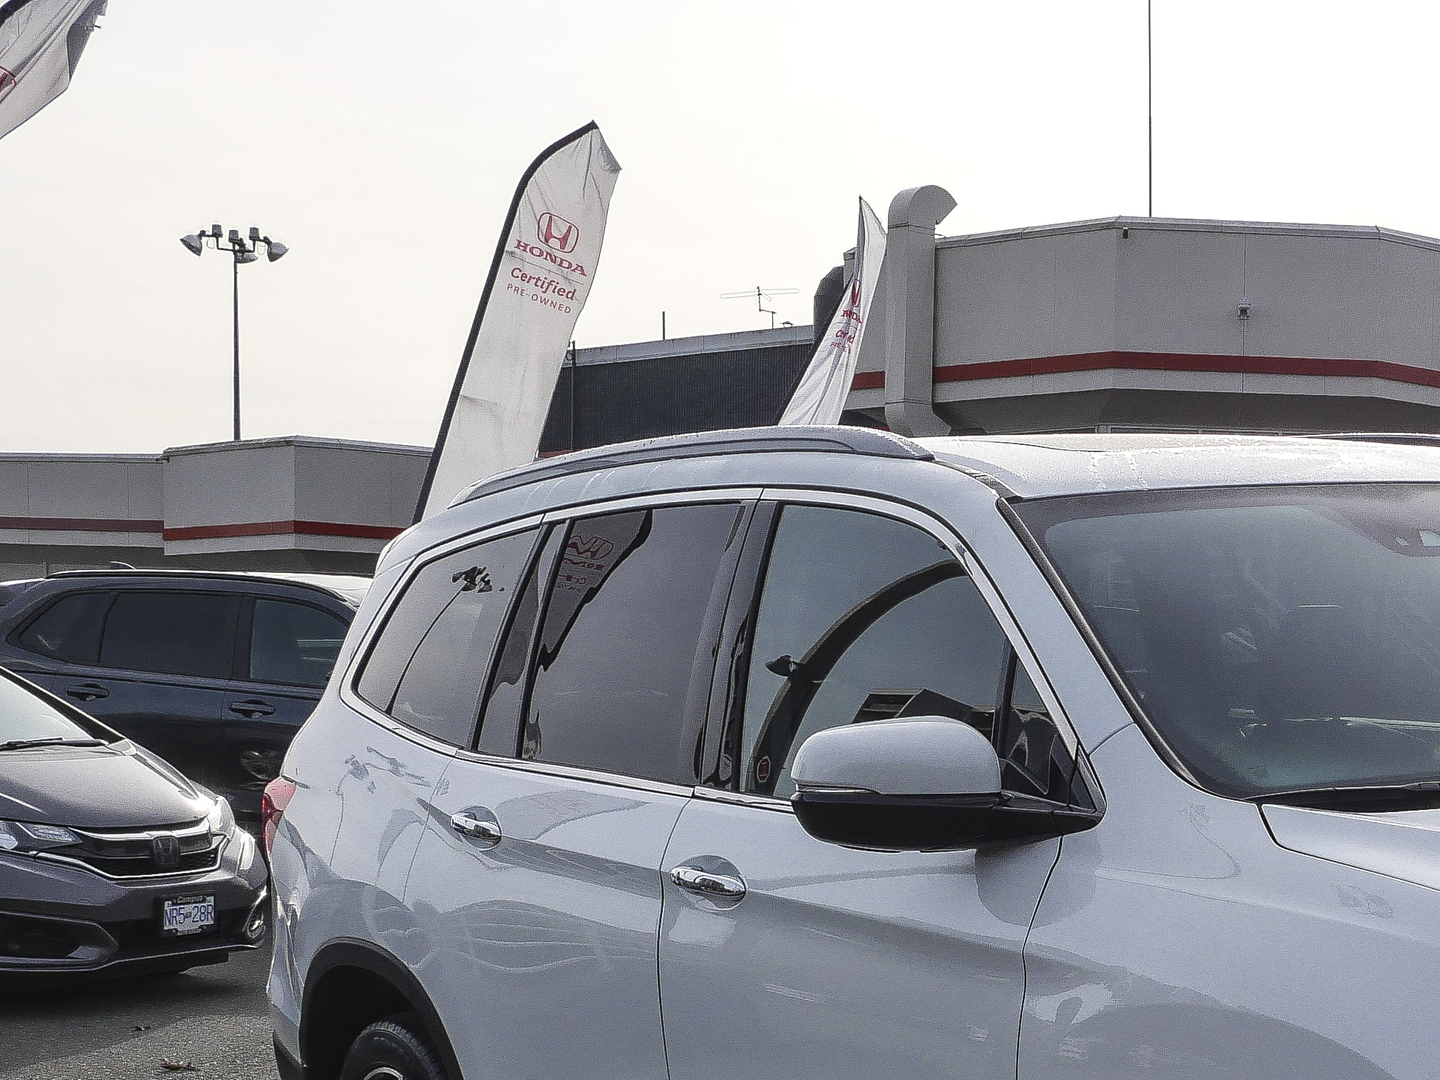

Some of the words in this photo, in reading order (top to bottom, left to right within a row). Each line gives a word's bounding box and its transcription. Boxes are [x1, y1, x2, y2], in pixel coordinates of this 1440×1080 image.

[514, 239, 587, 277] HONDA
[506, 283, 572, 314] PRE-OWNED
[510, 267, 577, 300] Certified
